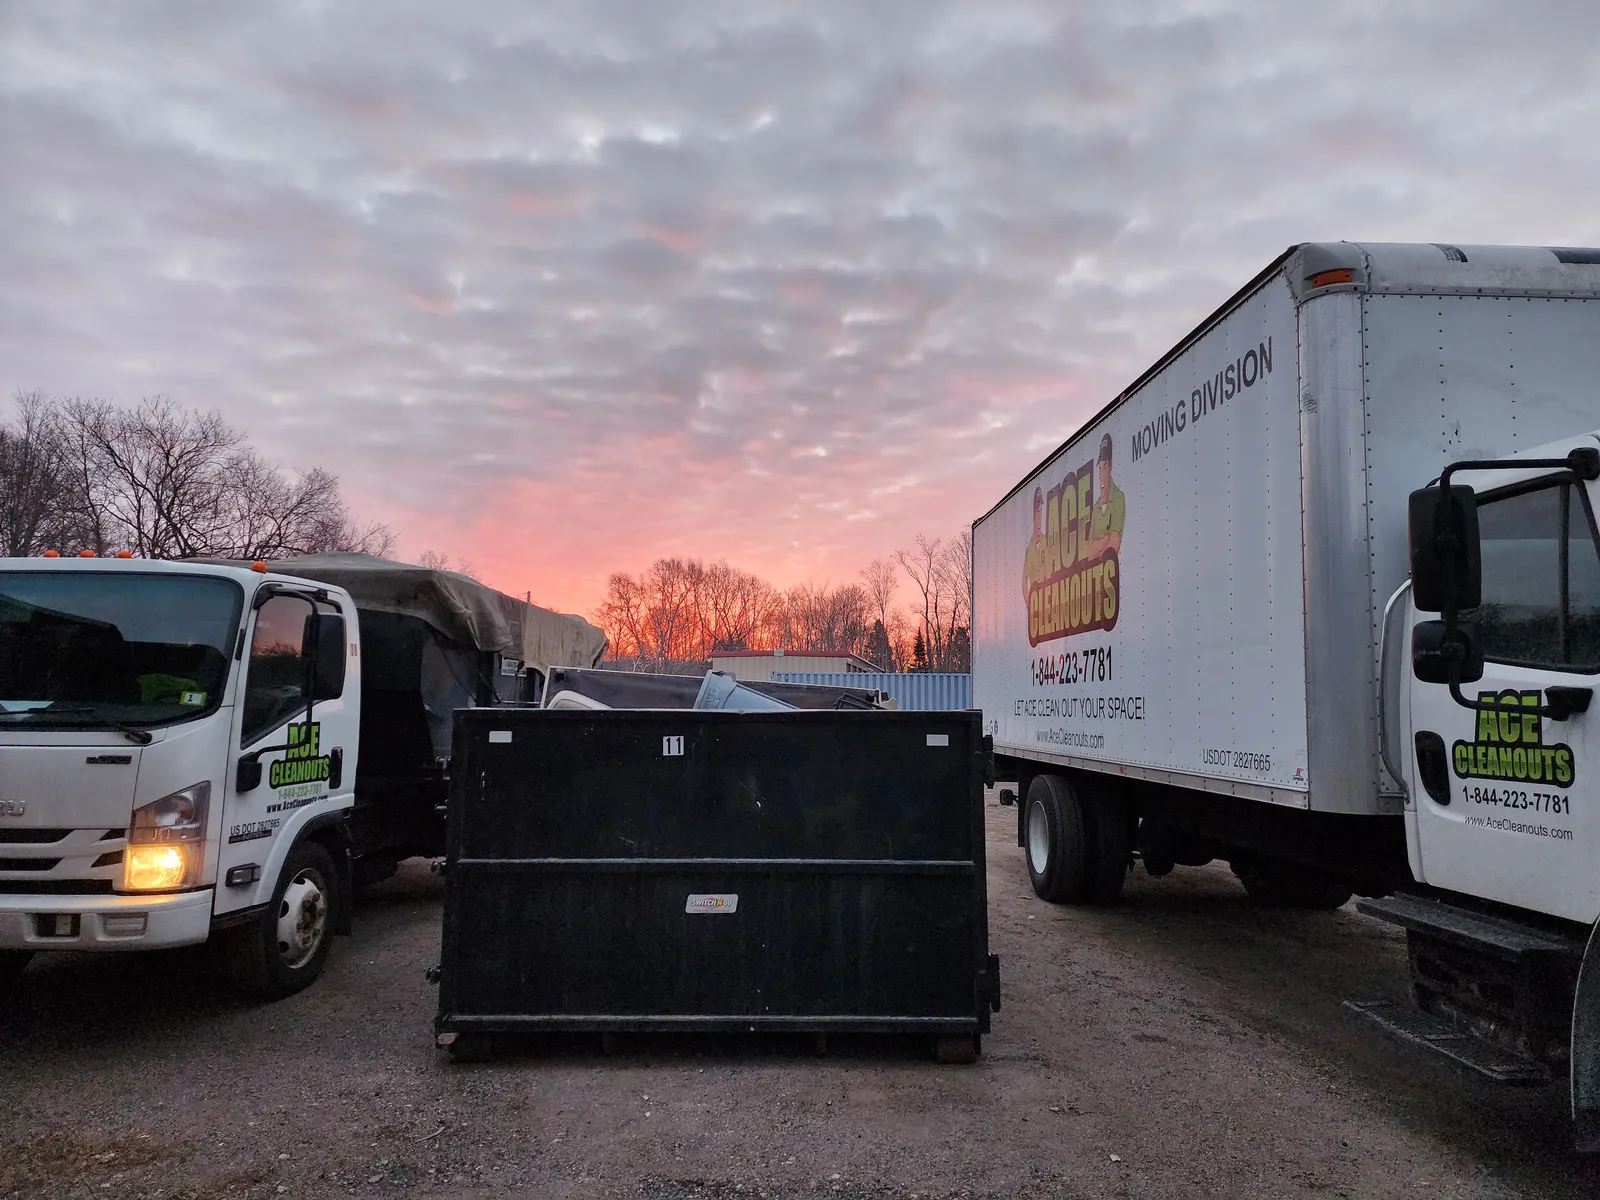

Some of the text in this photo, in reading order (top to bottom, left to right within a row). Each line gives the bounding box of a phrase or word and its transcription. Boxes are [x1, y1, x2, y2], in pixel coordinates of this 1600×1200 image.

[1132, 336, 1273, 463] MOVING DIVISION
[1047, 471, 1092, 574] ACE
[1030, 558, 1116, 639] CLEANOUTS
[1031, 645, 1112, 687] 1-844-223-7781
[1014, 696, 1146, 720] LET ACE CLEAN OUT YOUR SPACE!
[1478, 695, 1539, 743] ACE
[287, 725, 319, 758] ACE
[666, 736, 681, 755] 11
[1036, 727, 1105, 749] www.AceCleanouts.com
[270, 757, 330, 786] CLEANOUTS
[1202, 748, 1271, 772] USDOT 2827665
[1454, 744, 1572, 783] CLEANOUTS
[1462, 785, 1570, 815] 1-844-223-7781
[230, 824, 241, 836] US
[241, 822, 257, 834] DOT
[257, 817, 281, 831] 2827665
[1464, 814, 1573, 841] www.AceCleanouts.com
[691, 898, 716, 907] SWITCH
